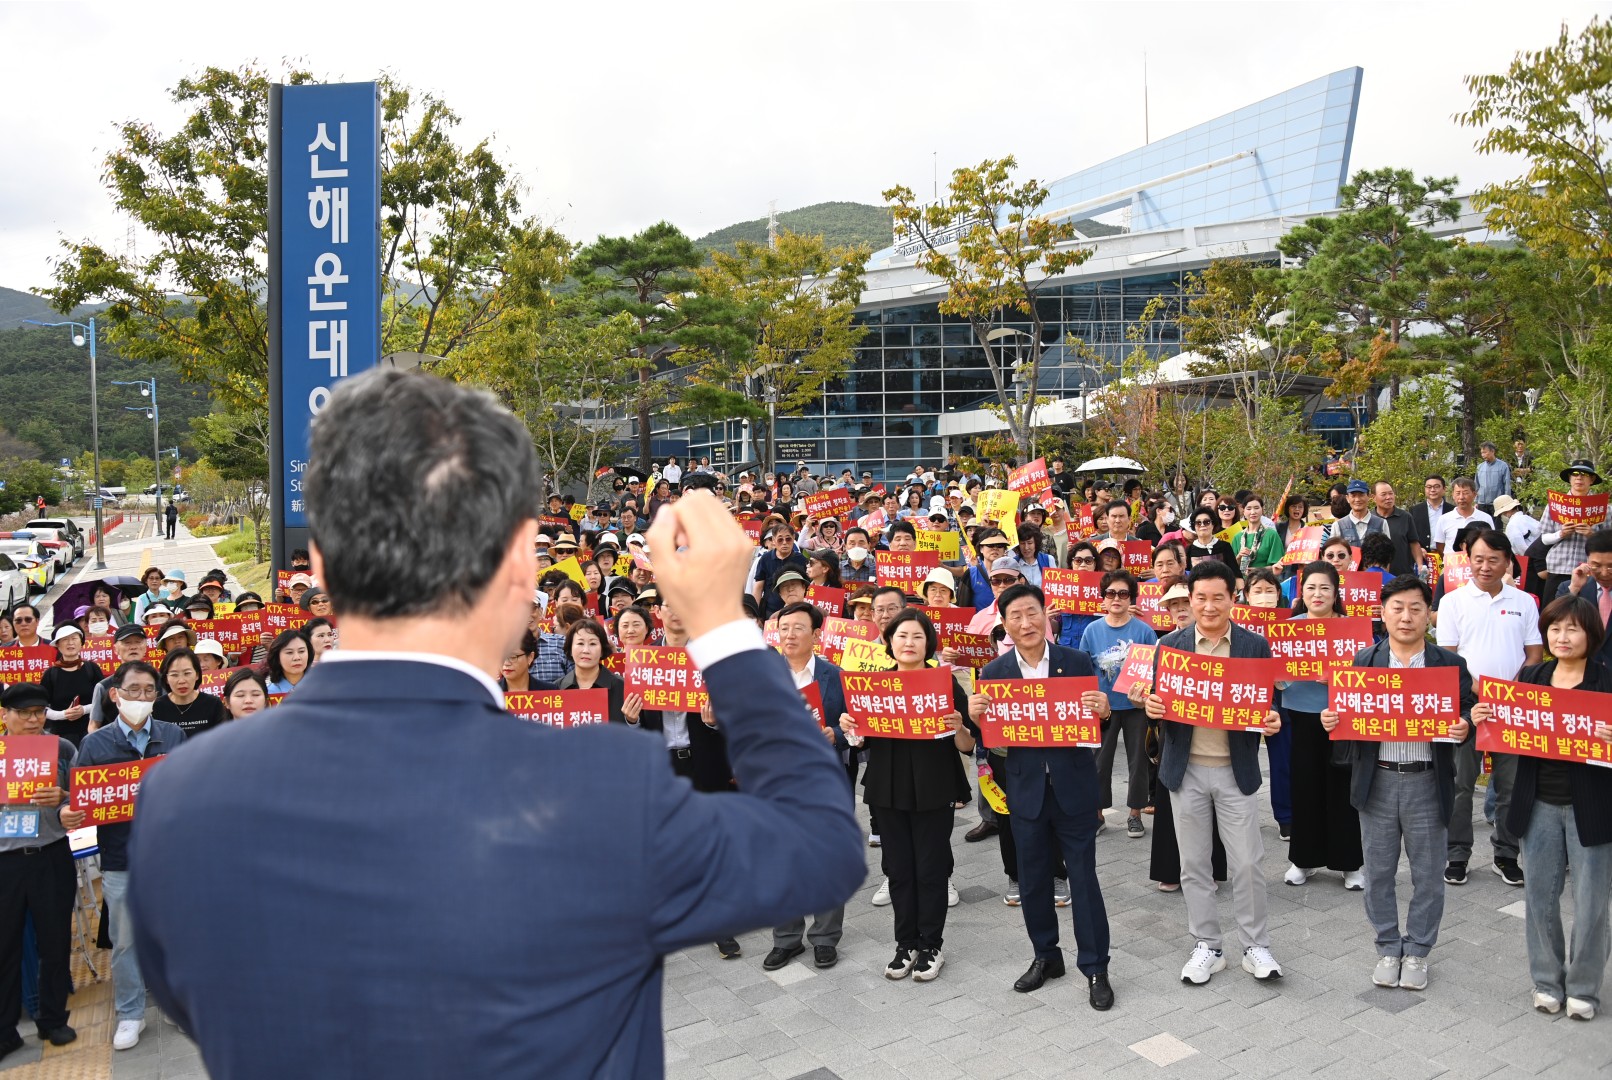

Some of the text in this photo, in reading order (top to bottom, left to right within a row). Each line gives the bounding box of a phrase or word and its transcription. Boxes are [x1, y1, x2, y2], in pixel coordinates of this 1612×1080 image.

[1548, 492, 1582, 506] KTX-이음
[1550, 502, 1605, 517] 신해운대역 정차로
[877, 552, 912, 565] KTX-이음
[1128, 554, 1150, 565] 정차로
[878, 565, 912, 580] 신해운대역
[1044, 571, 1079, 584] KTX-이음
[1044, 582, 1079, 599] 신해운대역
[1349, 587, 1378, 603] 정차로
[217, 630, 239, 642] 정차로
[826, 620, 869, 637] KTX-이음
[1267, 623, 1327, 640] KTX-이음
[630, 649, 688, 666] KTX-이음
[1270, 639, 1328, 659] 신해운대역
[28, 659, 50, 673] 정차로
[1161, 650, 1225, 678] KTX-이음
[1286, 661, 1324, 678] 해운대
[631, 668, 687, 689] 신해운대역
[843, 676, 904, 693] KTX-이음
[1332, 670, 1403, 689] KTX-이음
[979, 683, 1046, 699] KTX-이음
[1158, 671, 1269, 705] 신해운대역 정차로
[1481, 679, 1553, 707] KTX-이음
[505, 694, 564, 711] KTX-이음
[644, 691, 681, 709] 해운대
[849, 692, 950, 715] 신해운대역 정차로
[1334, 692, 1454, 715] 신해운대역 정차로
[983, 701, 1095, 722] 신해운대역 정차로
[1171, 699, 1215, 724] 해운대
[866, 716, 905, 734] 해운대
[1001, 724, 1098, 743] 해운대 발전을!
[1351, 717, 1397, 737] 해운대
[1500, 728, 1612, 762] 해운대 발전을!
[13, 758, 52, 778] 정차로
[75, 765, 142, 785] KTX-이음
[92, 803, 135, 820] 해운대
[3, 814, 37, 834] 진행
